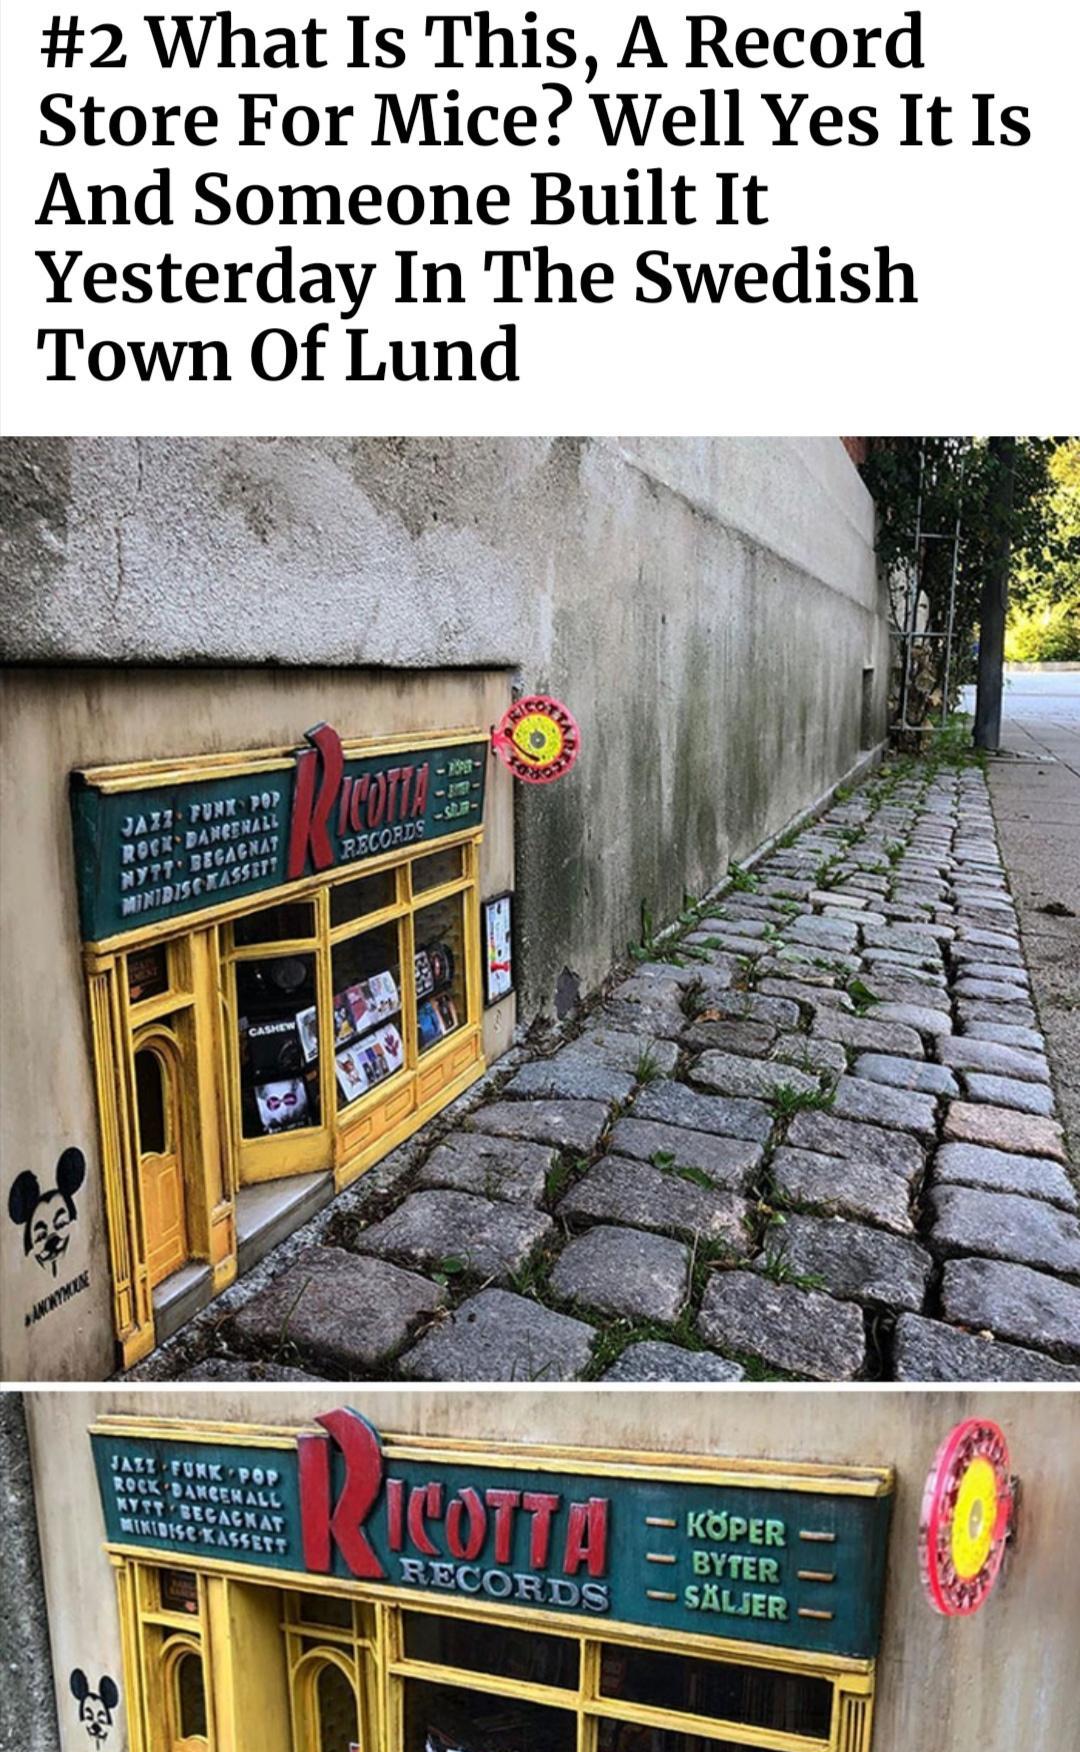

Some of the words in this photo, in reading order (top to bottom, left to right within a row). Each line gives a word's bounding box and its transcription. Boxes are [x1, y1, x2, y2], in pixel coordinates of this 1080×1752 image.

[121, 810, 173, 837] JAZZ
[189, 799, 236, 823] FUNK
[250, 791, 280, 811] POP
[122, 835, 172, 864] ROCK
[185, 814, 279, 849] DANCEHALL
[341, 820, 425, 859] RECORDS
[121, 860, 173, 890] NYTT
[111, 1455, 155, 1474] JAZZ
[171, 1460, 222, 1481] FUNK
[238, 1467, 278, 1487] POP
[113, 1476, 161, 1495] ROCK
[172, 1482, 281, 1508] DANCEHALL
[117, 1497, 164, 1517] NYTT
[687, 1509, 786, 1546] KÖPER
[400, 1558, 609, 1611] RECORDS
[692, 1551, 779, 1583] BYTER
[684, 1583, 788, 1620] SÄLJER
